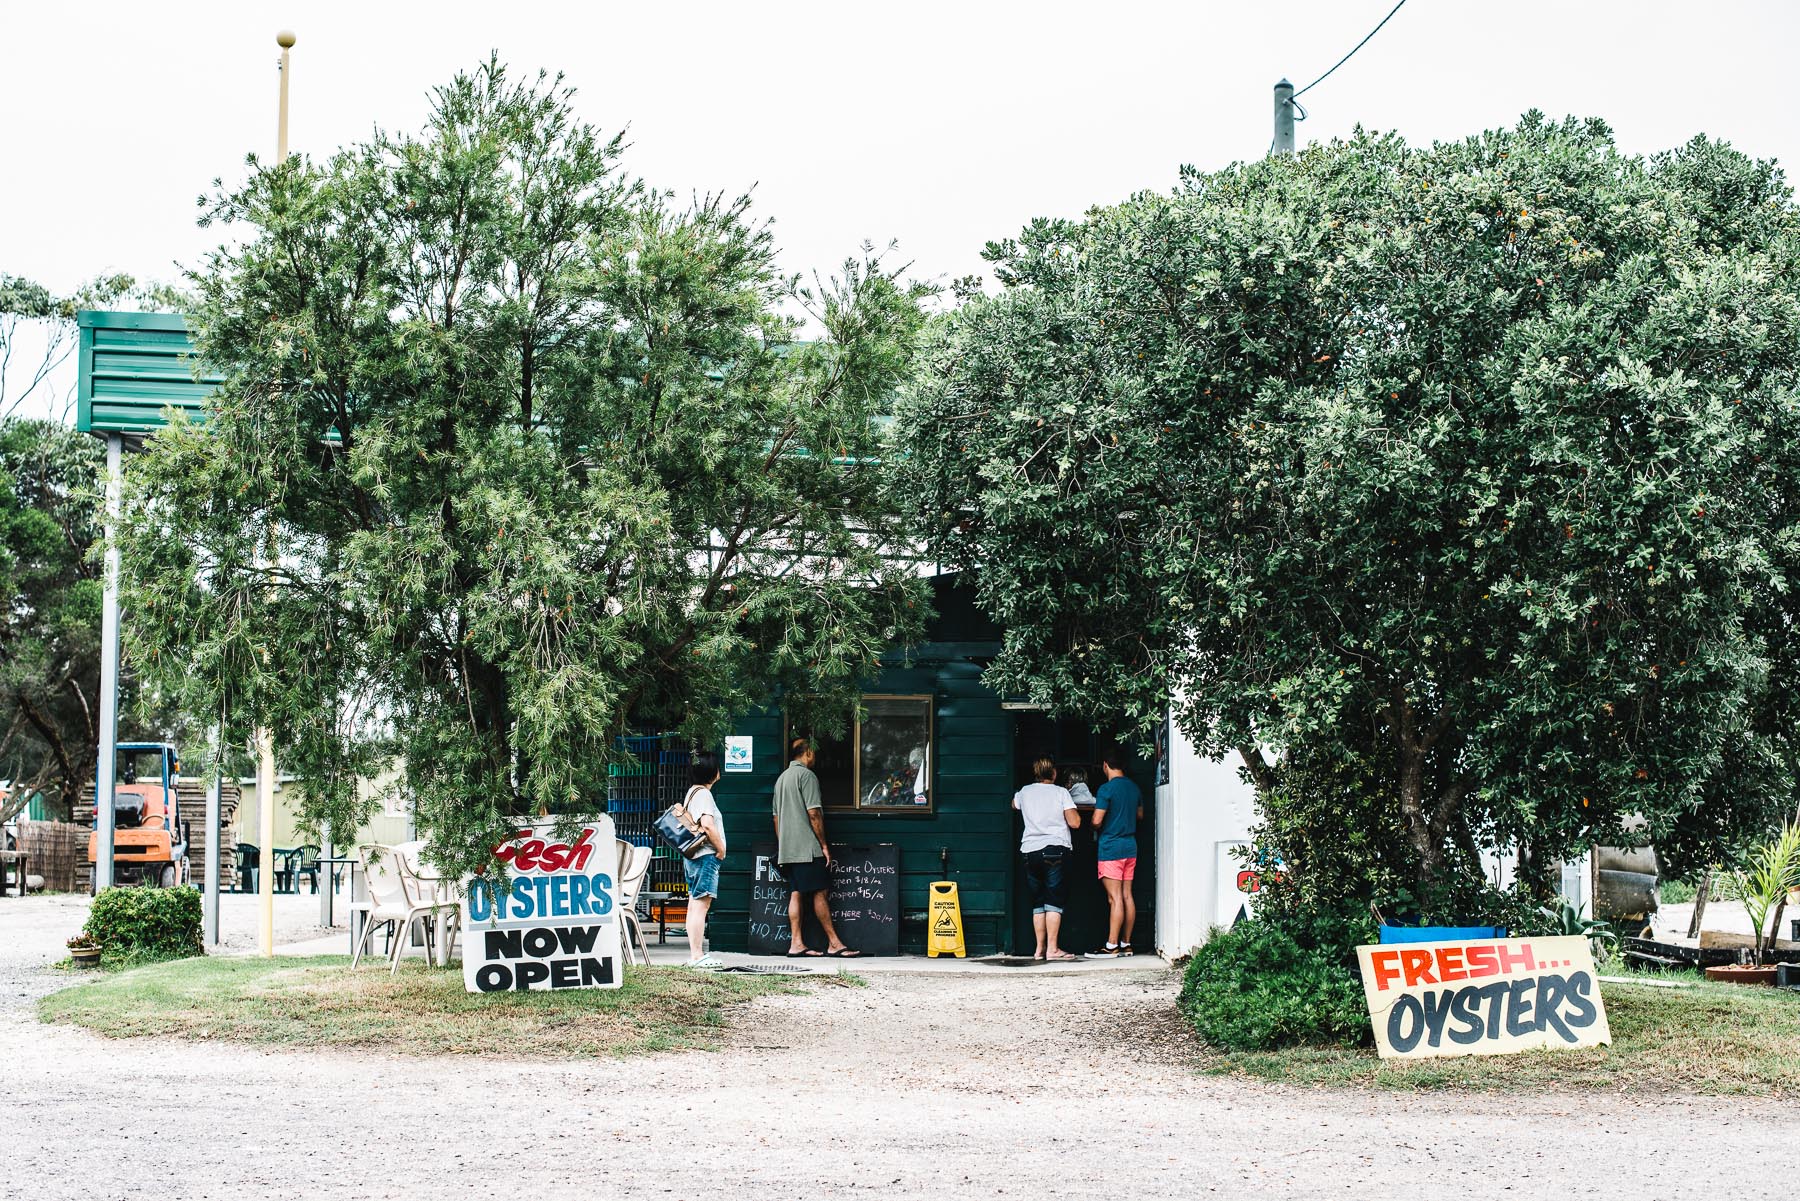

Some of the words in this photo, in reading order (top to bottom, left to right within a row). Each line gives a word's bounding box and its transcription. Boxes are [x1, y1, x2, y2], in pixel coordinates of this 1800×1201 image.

[477, 828, 595, 875] Fesh
[469, 873, 612, 921] OYSTERS
[753, 885, 787, 900] BLACK
[485, 926, 601, 960] NOW
[476, 956, 614, 993] OPEN
[1387, 971, 1597, 1052] OYSTERS
